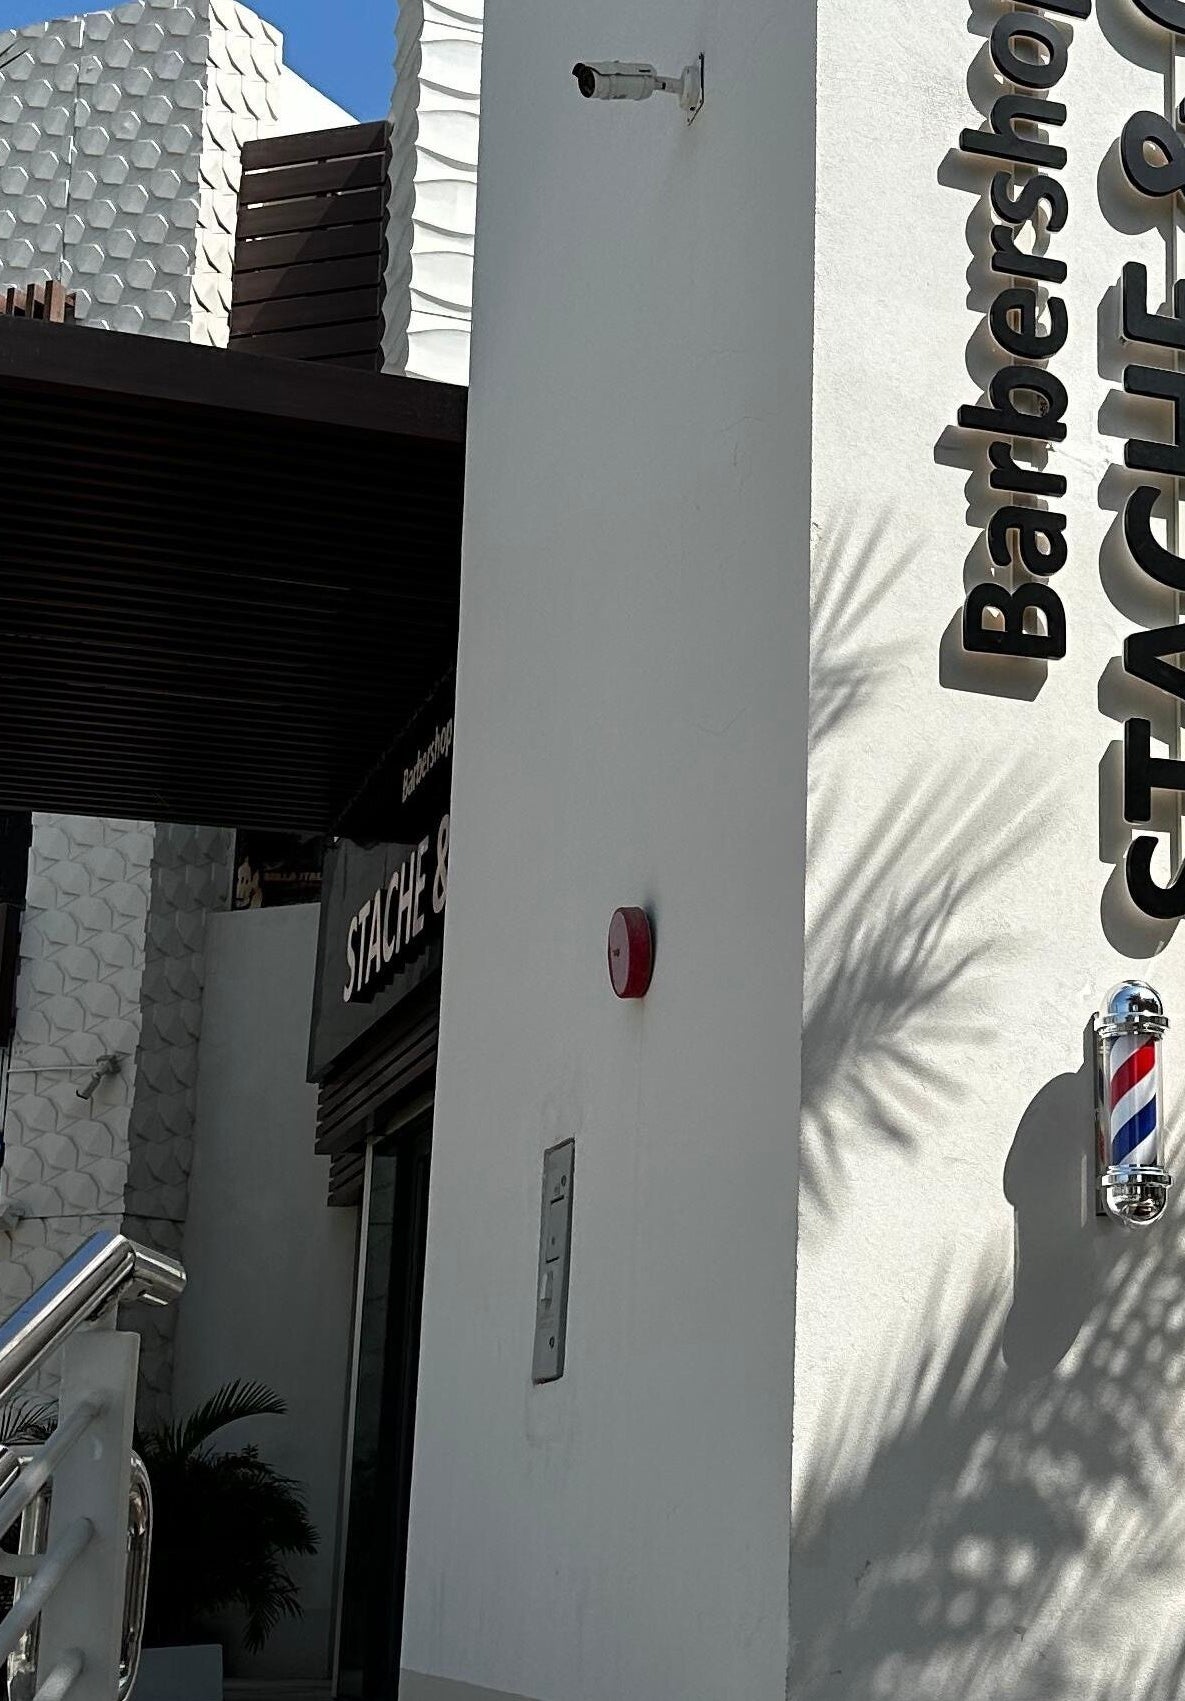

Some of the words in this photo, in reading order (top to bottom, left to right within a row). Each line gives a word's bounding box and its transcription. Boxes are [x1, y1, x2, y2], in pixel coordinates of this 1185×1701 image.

[402, 718, 453, 804] Barbershop
[344, 835, 429, 1002] STACHE
[432, 814, 450, 914] &
